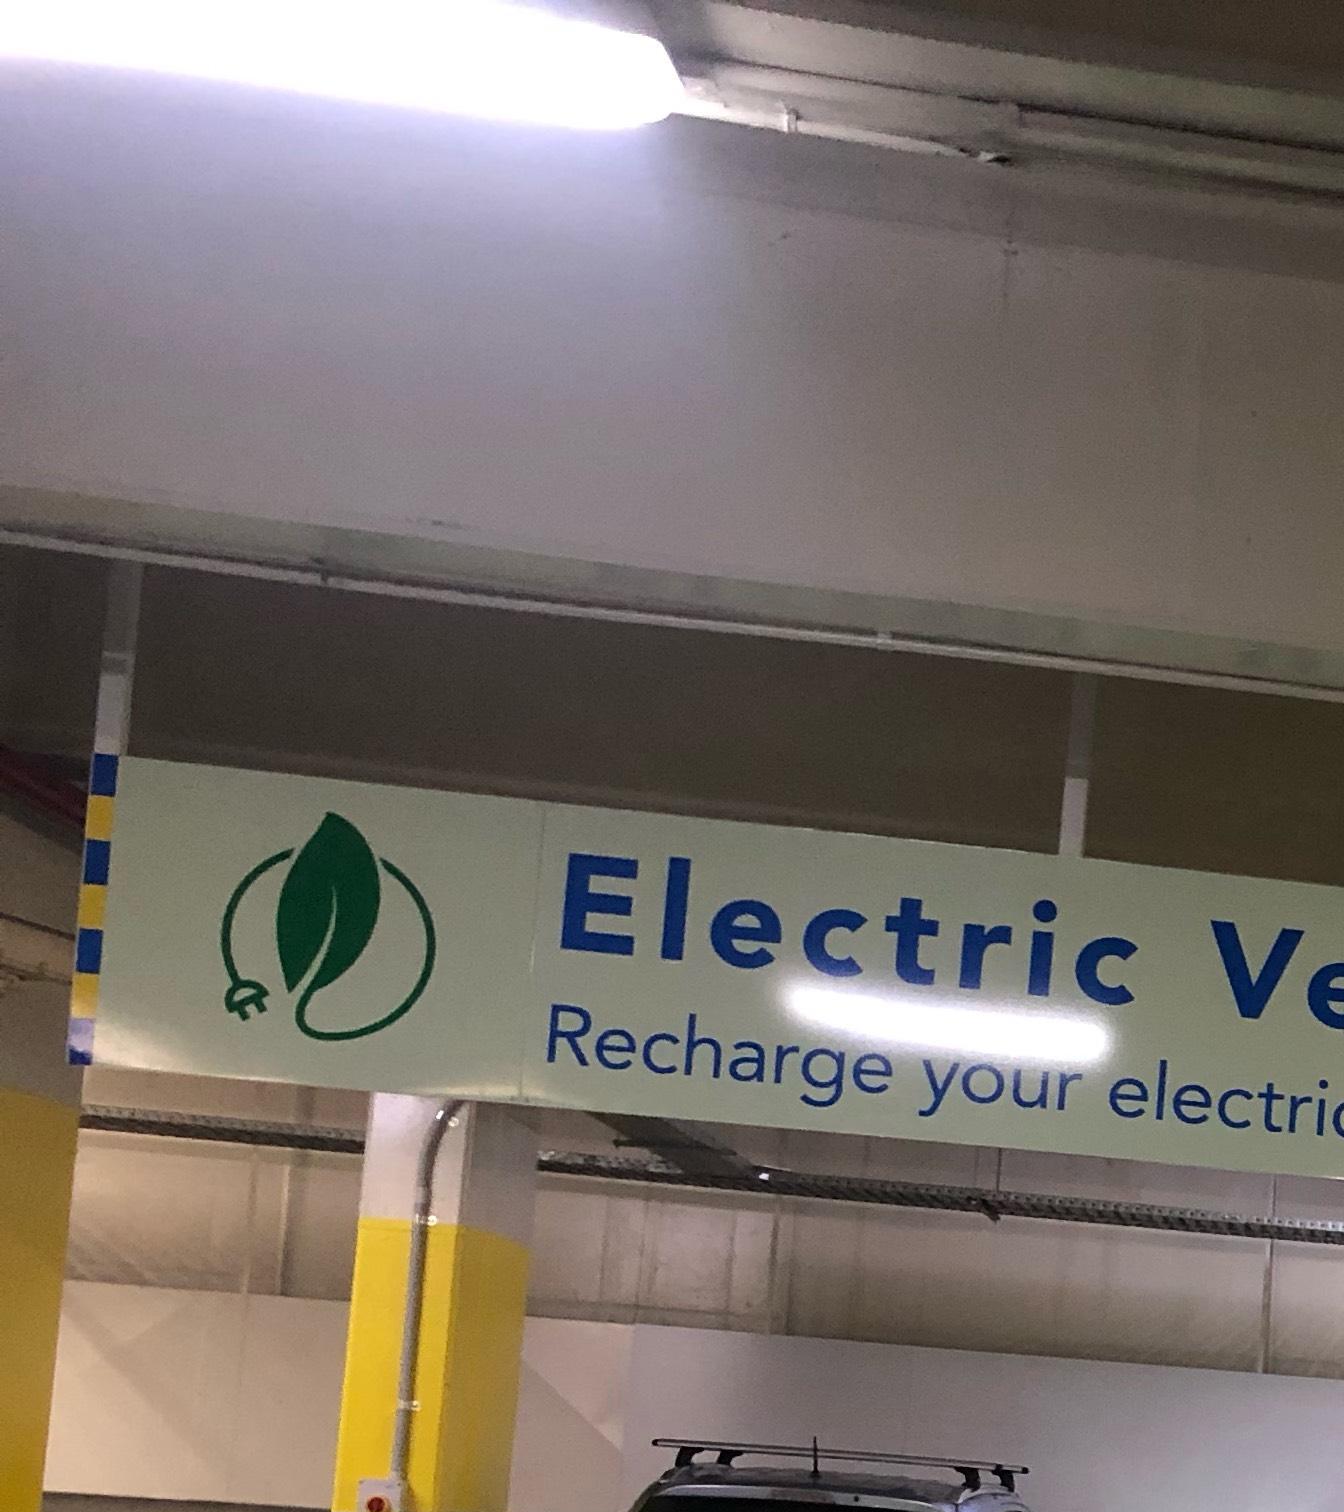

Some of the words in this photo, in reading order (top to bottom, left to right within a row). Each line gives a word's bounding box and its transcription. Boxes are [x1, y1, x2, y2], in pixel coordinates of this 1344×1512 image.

[559, 852, 1138, 1005] Electric
[546, 1003, 893, 1108] Recharge
[918, 1058, 1083, 1117] your
